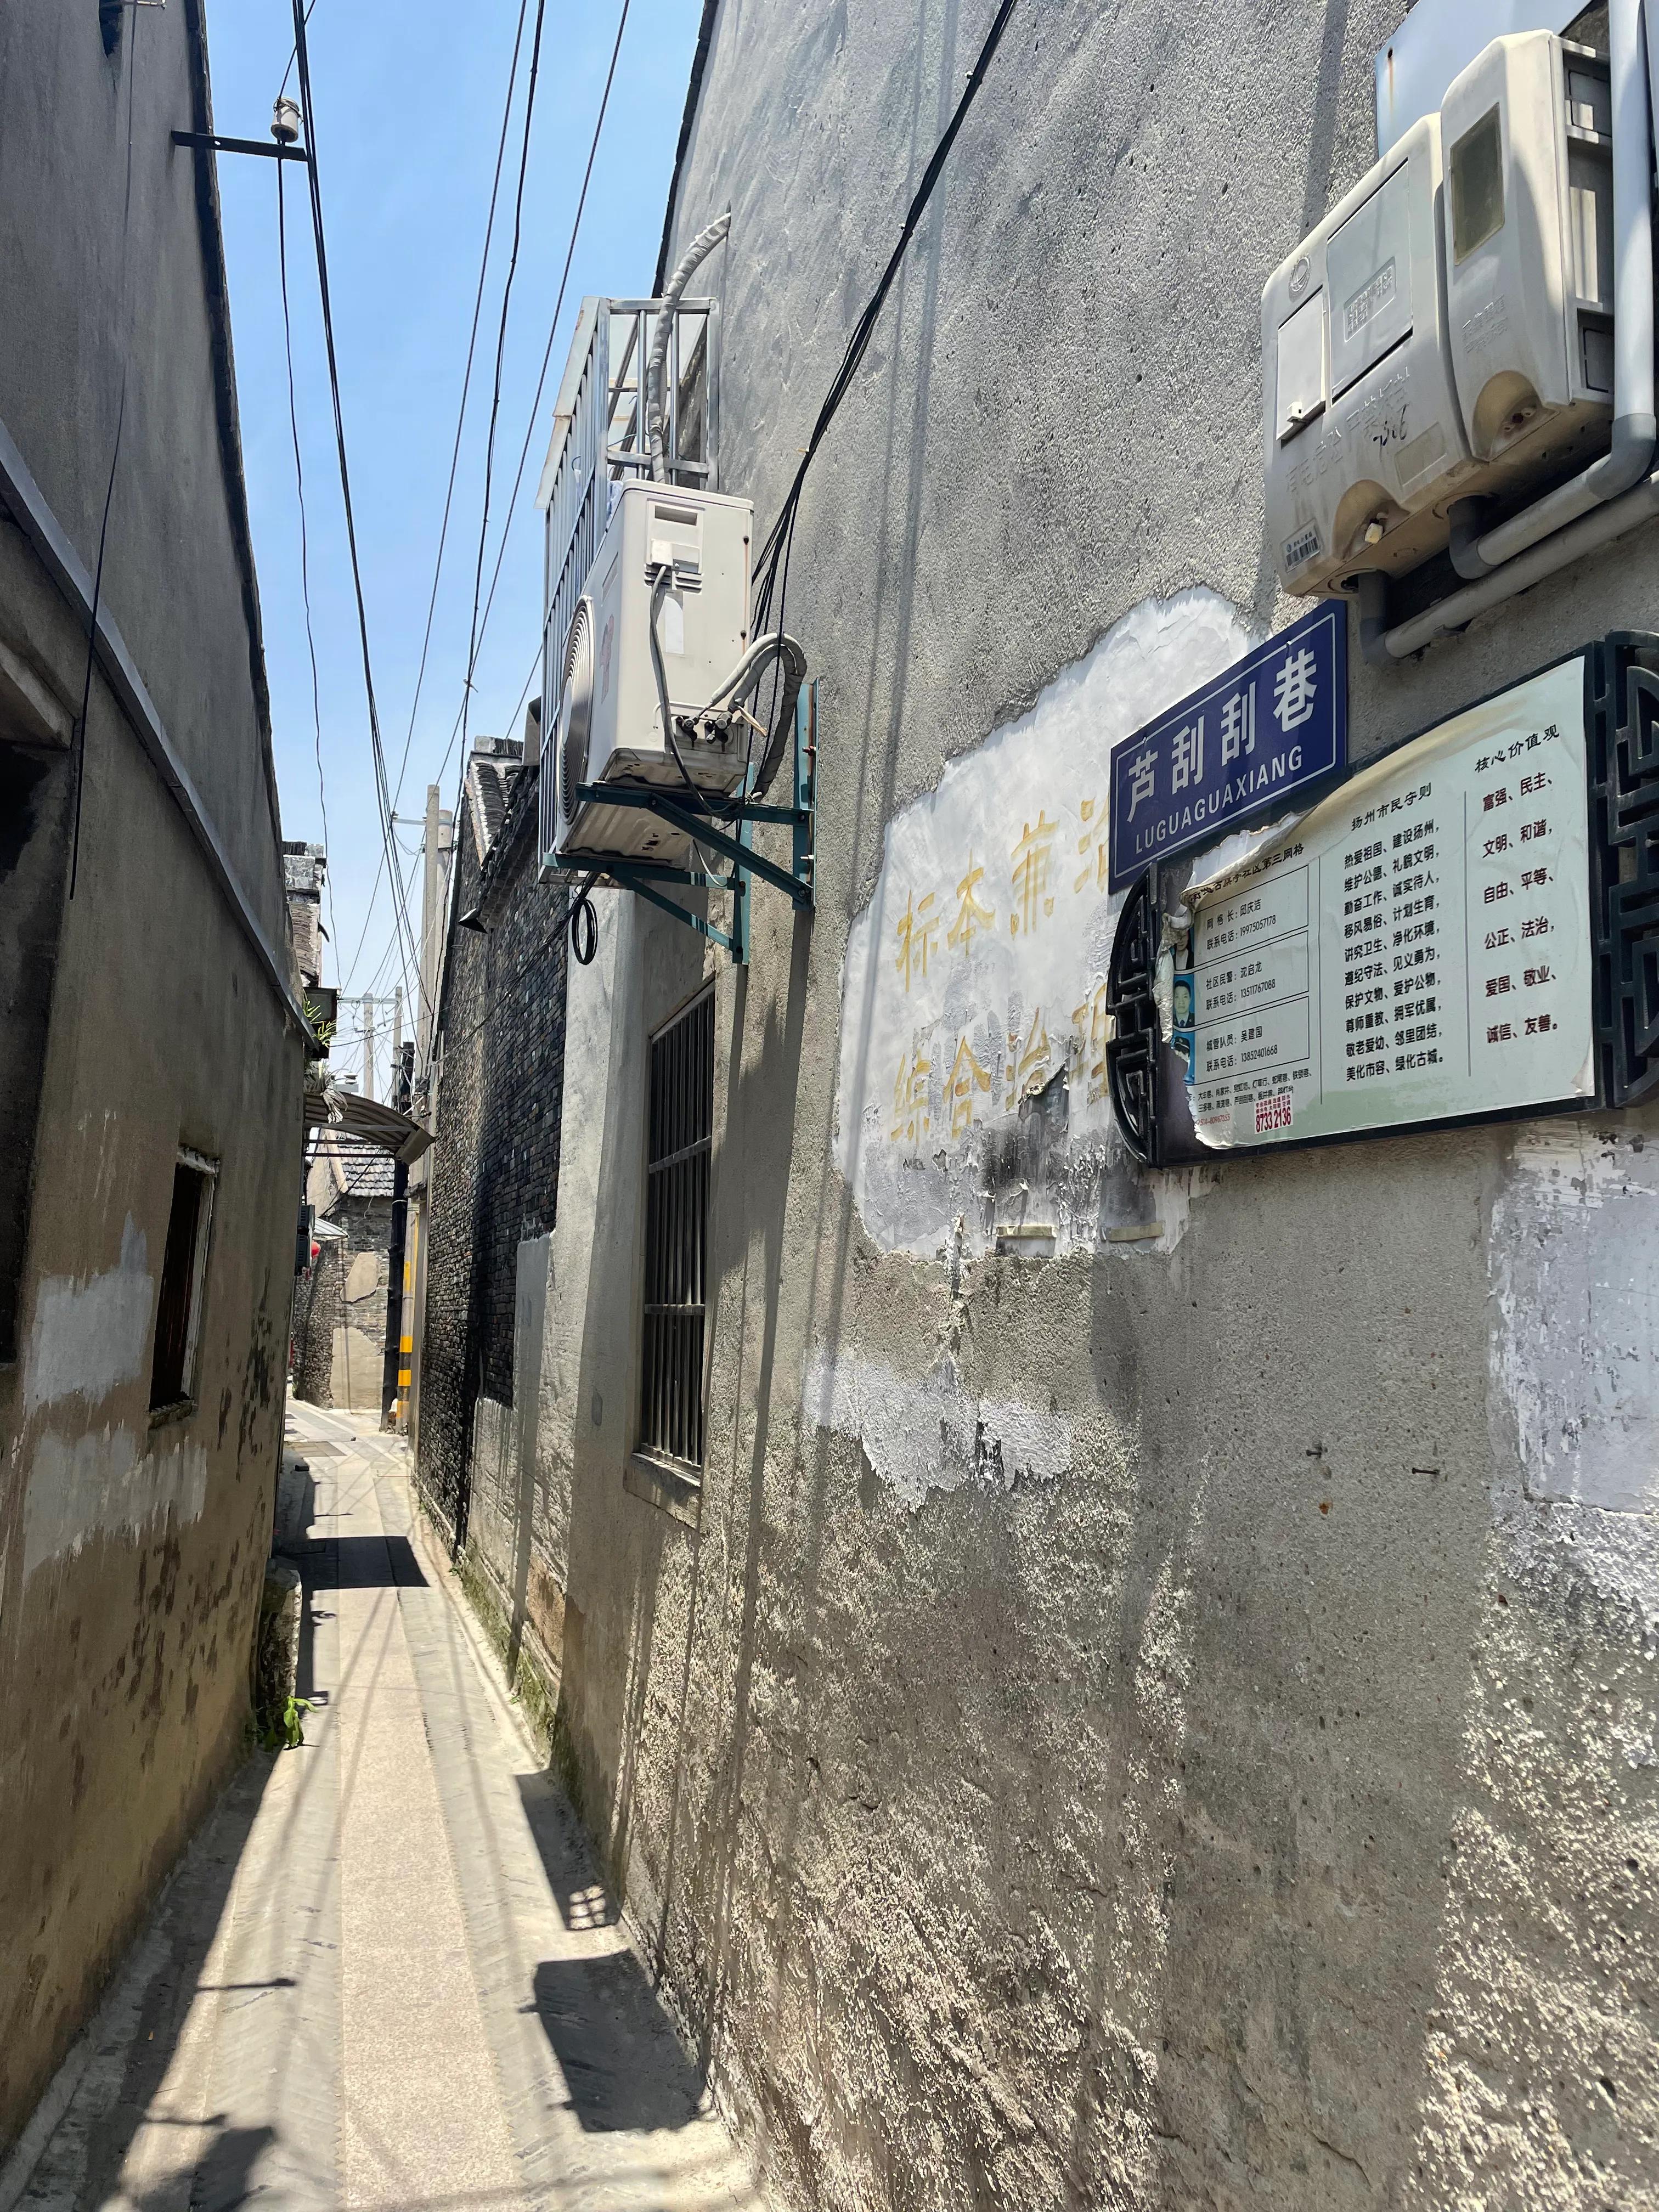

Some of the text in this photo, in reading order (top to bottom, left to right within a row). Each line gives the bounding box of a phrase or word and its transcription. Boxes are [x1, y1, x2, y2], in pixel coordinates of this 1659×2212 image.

[1127, 648, 1318, 822] 芦刮刮巷
[1475, 724, 1559, 772] 核心价值观
[1136, 746, 1302, 854] LUGUAGUAXIANG
[1351, 782, 1431, 831] 扬州市民守则
[1256, 1107, 1291, 1133] 8733 2136
